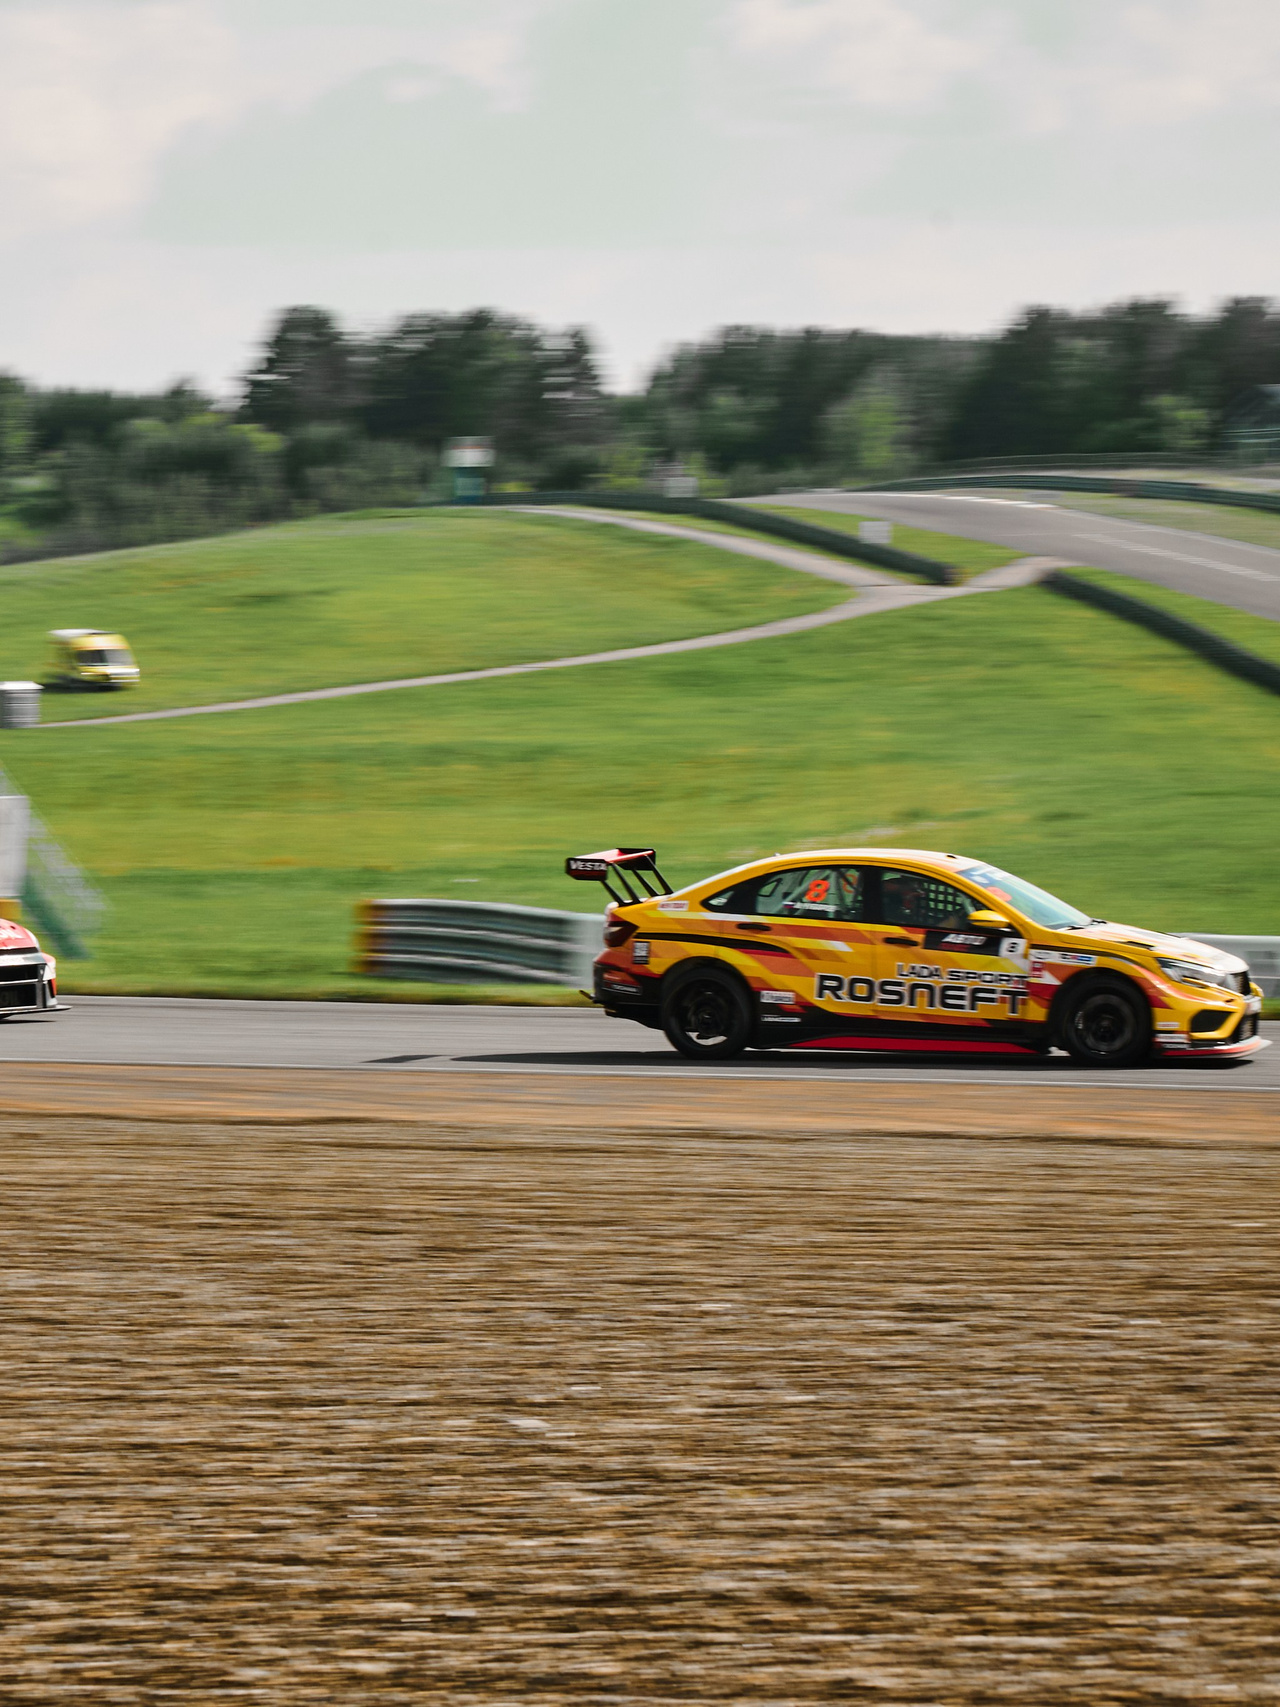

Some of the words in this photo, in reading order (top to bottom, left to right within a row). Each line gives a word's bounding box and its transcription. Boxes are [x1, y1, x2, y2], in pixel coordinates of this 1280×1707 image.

[570, 860, 607, 871] VESTA
[805, 880, 830, 902] 8
[1006, 942, 1019, 953] 8
[896, 962, 943, 980] LADA
[946, 968, 1027, 988] SPORT
[814, 972, 1029, 1016] ROSNEFT
